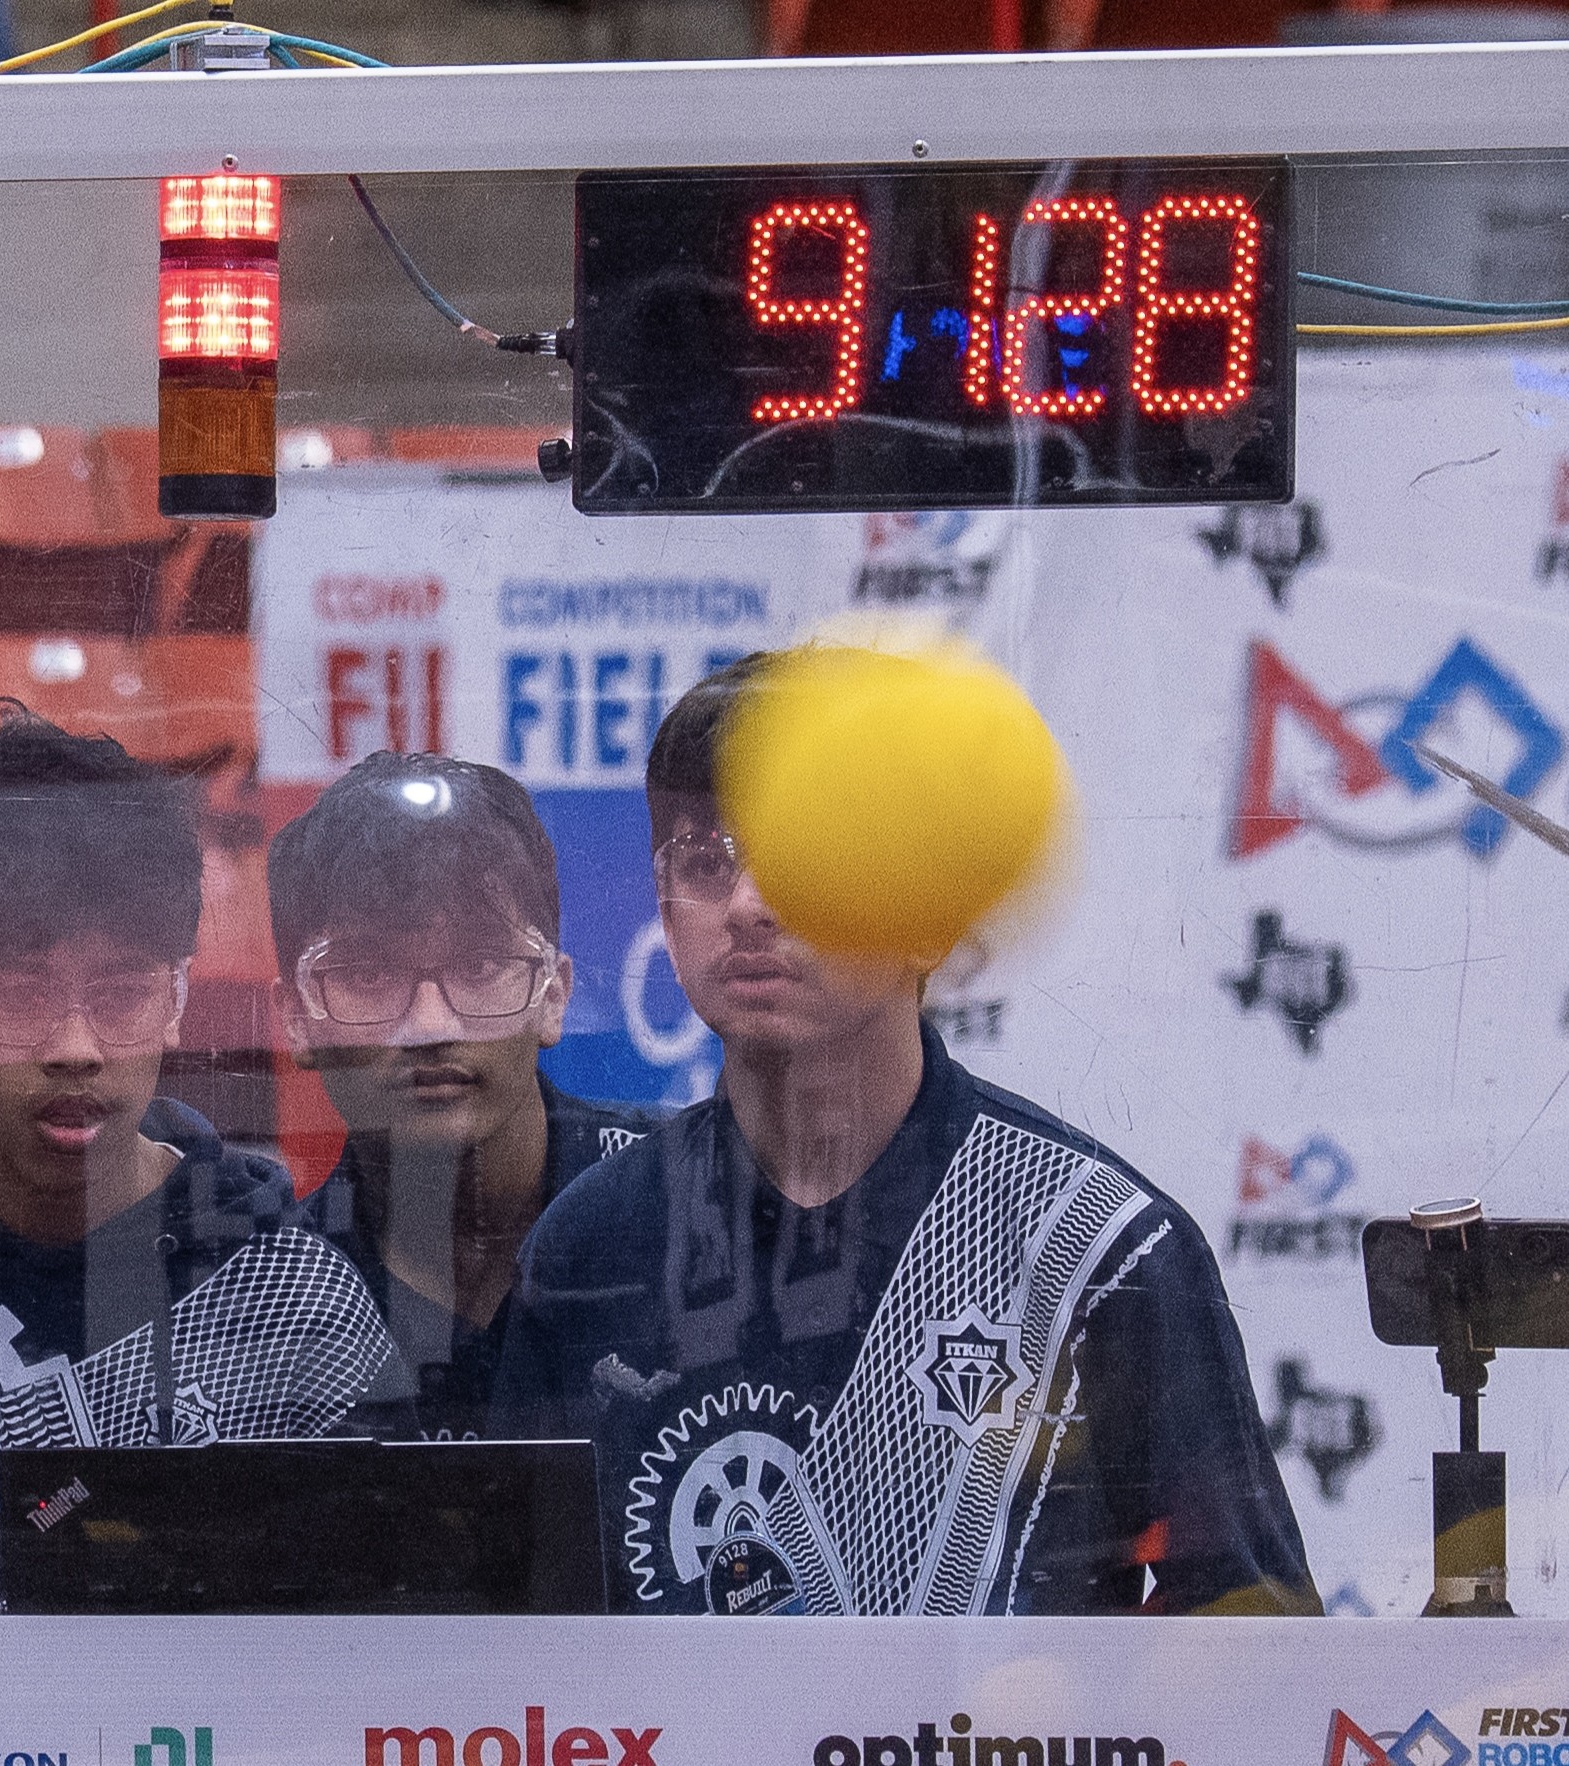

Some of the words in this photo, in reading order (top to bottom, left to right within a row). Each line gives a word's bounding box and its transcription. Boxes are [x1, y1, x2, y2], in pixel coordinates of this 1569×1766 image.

[748, 196, 1260, 422] 9128
[945, 1342, 998, 1359] ITKAN
[26, 1475, 90, 1533] ThinkPad
[718, 1543, 748, 1568] 9128
[365, 1706, 664, 1766] molex
[813, 1713, 1188, 1766] optimum
